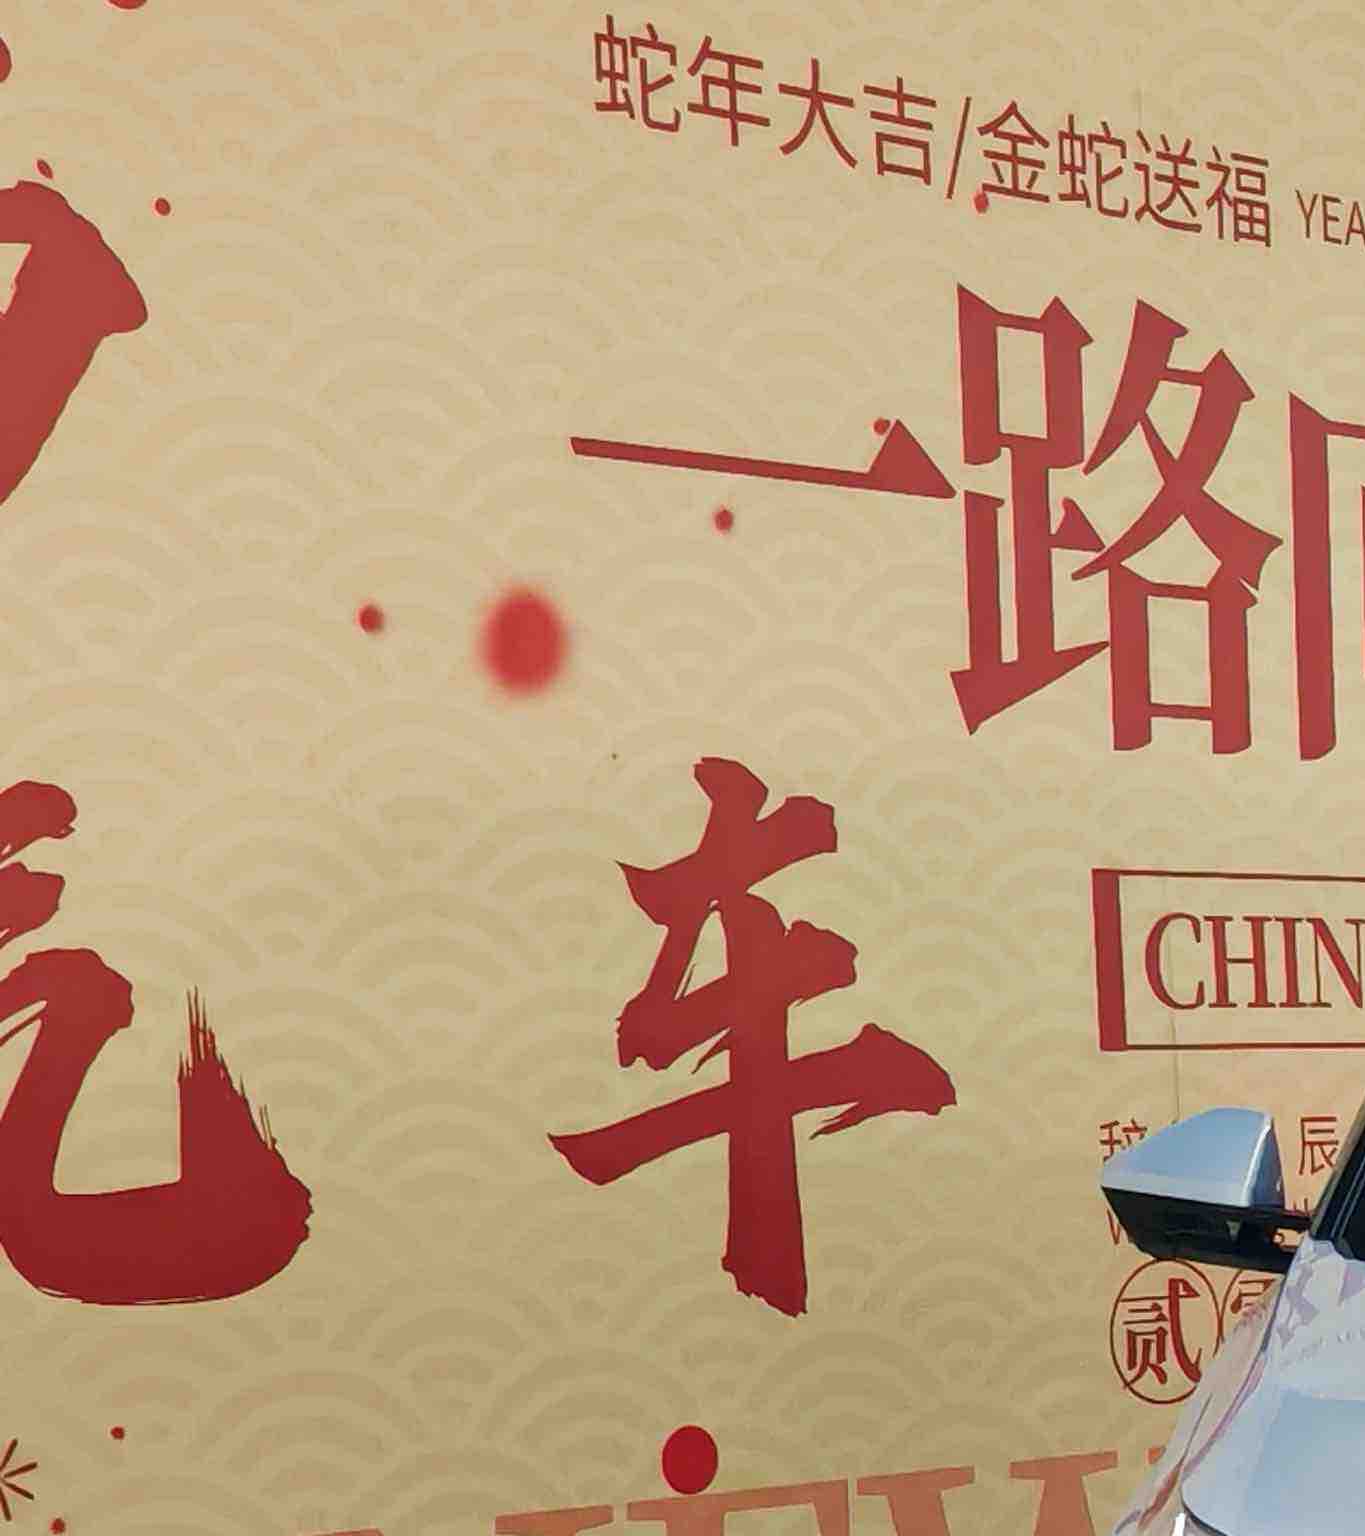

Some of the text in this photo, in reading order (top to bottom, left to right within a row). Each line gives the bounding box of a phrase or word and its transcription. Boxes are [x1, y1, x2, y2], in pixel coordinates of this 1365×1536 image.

[593, 14, 1272, 247] 蛇年大吉/金蛇送福
